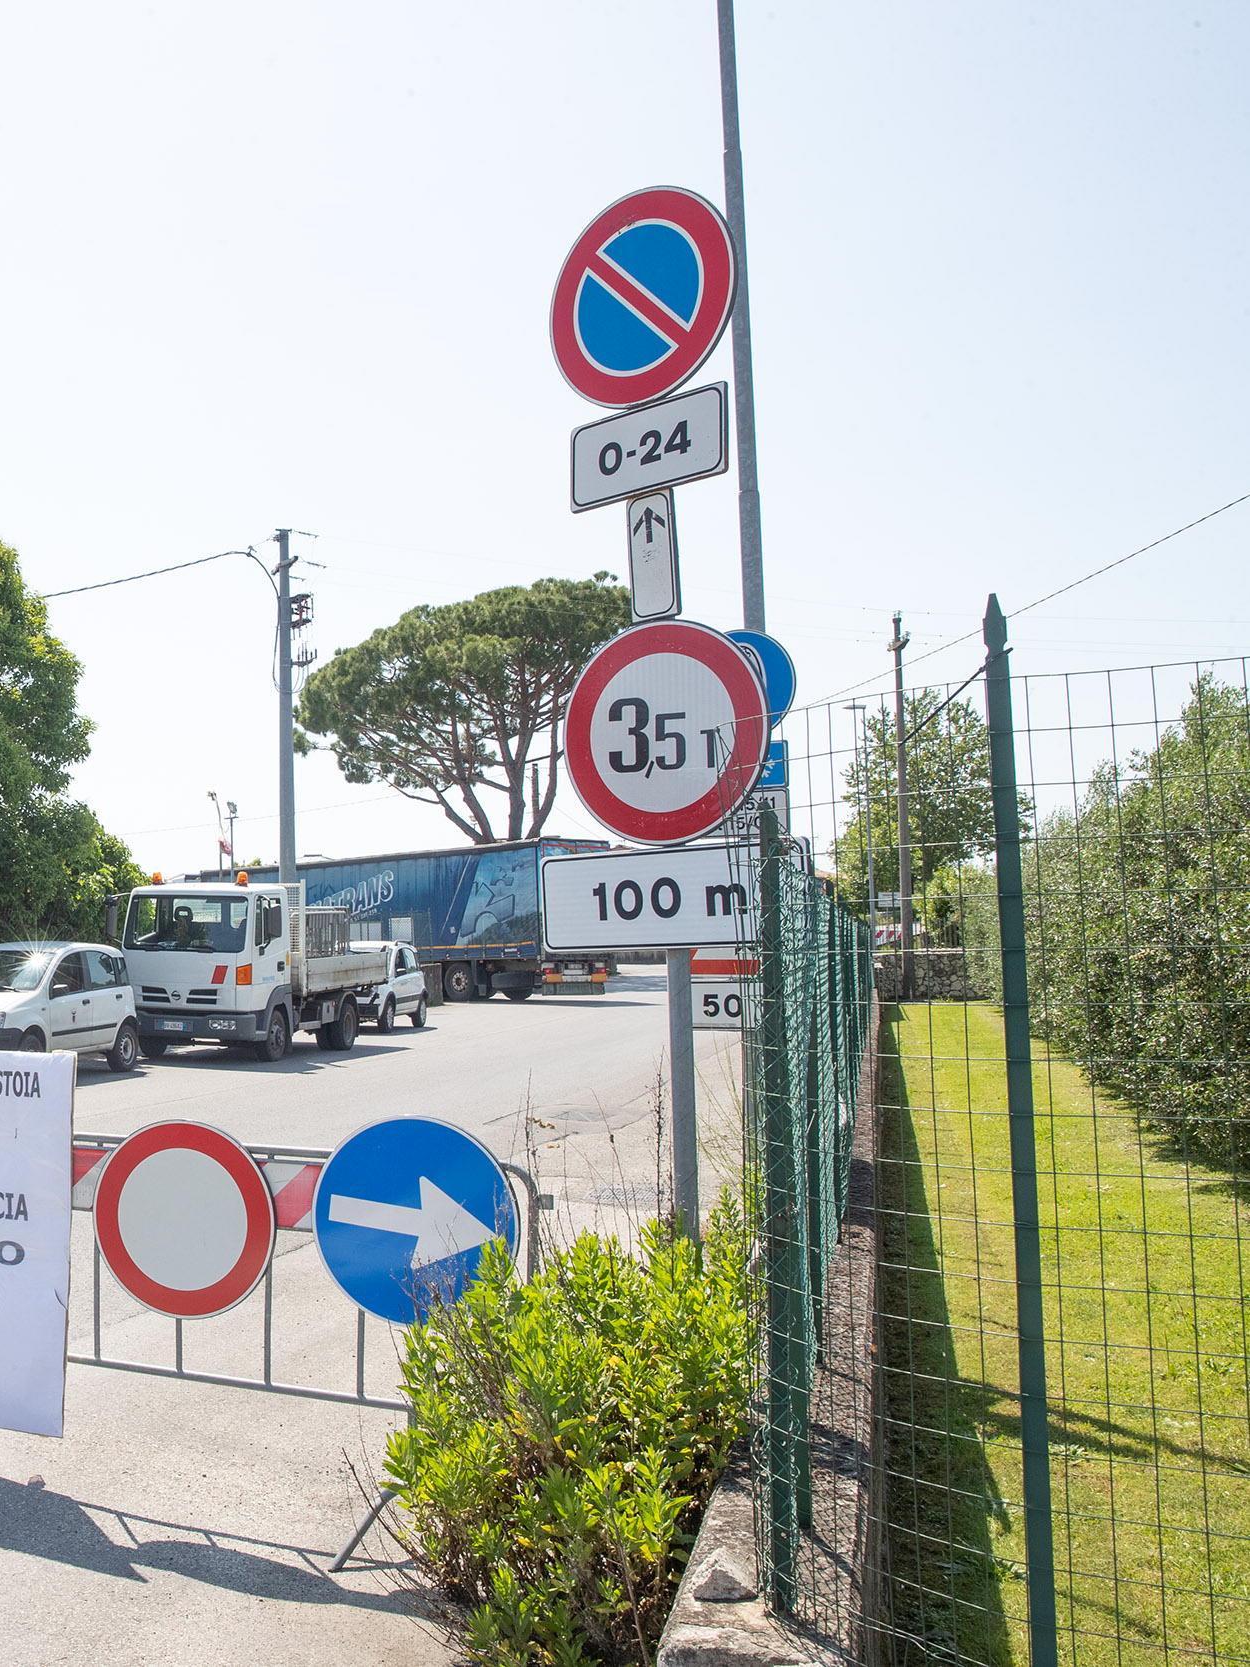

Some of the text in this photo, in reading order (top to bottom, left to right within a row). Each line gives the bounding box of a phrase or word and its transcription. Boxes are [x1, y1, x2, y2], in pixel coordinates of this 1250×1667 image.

[598, 419, 692, 476] 0-24
[607, 697, 686, 779] 3,5
[592, 876, 749, 921] 100 m
[702, 993, 742, 1018] 50
